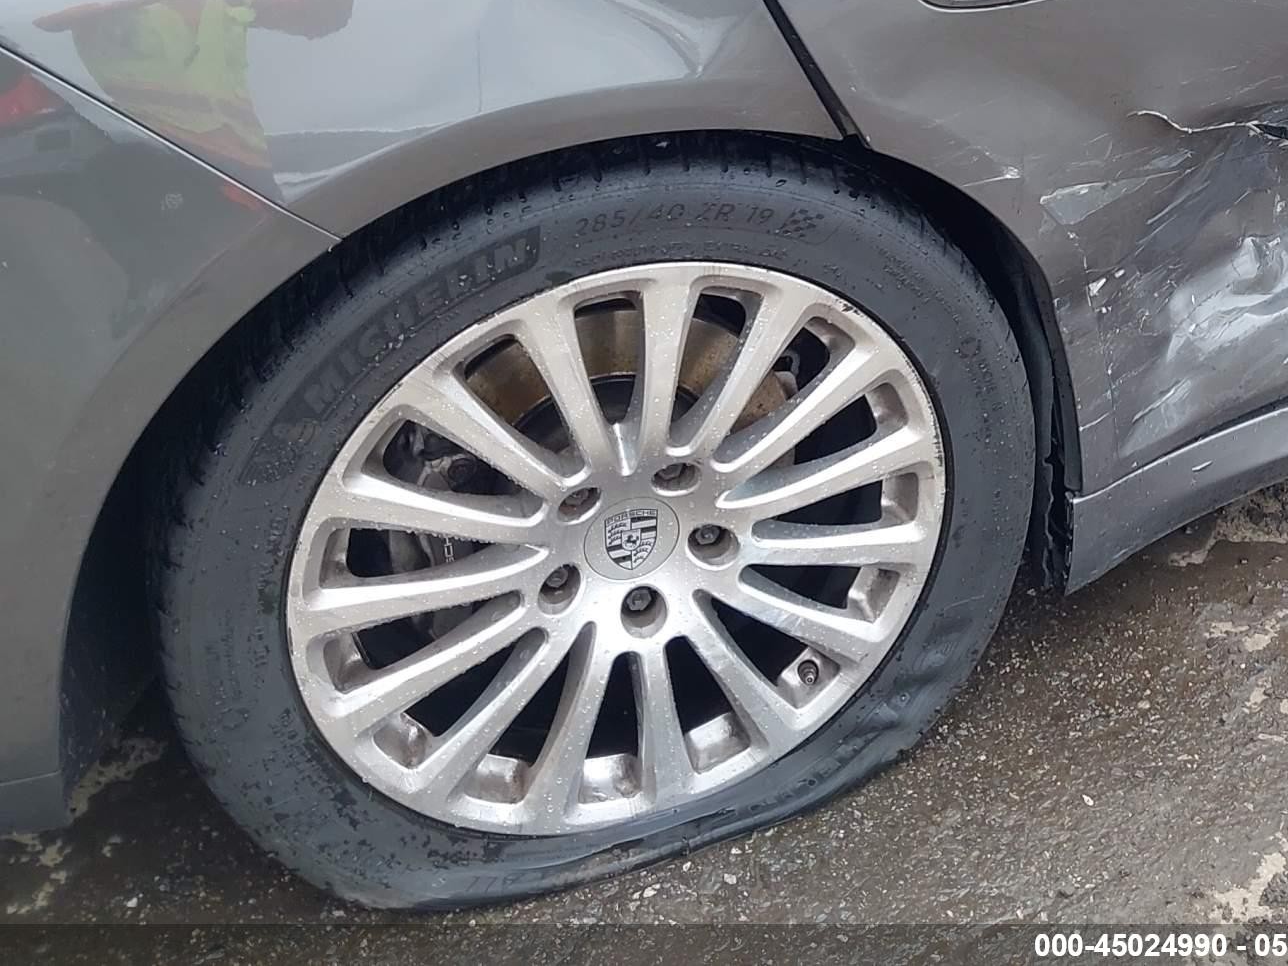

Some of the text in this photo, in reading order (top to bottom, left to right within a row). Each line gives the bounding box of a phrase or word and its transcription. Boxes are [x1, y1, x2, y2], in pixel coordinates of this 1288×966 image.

[696, 201, 737, 223] ZR
[745, 204, 775, 226] 19
[302, 236, 530, 414] MICHELIN
[606, 508, 658, 525] PORSCHE
